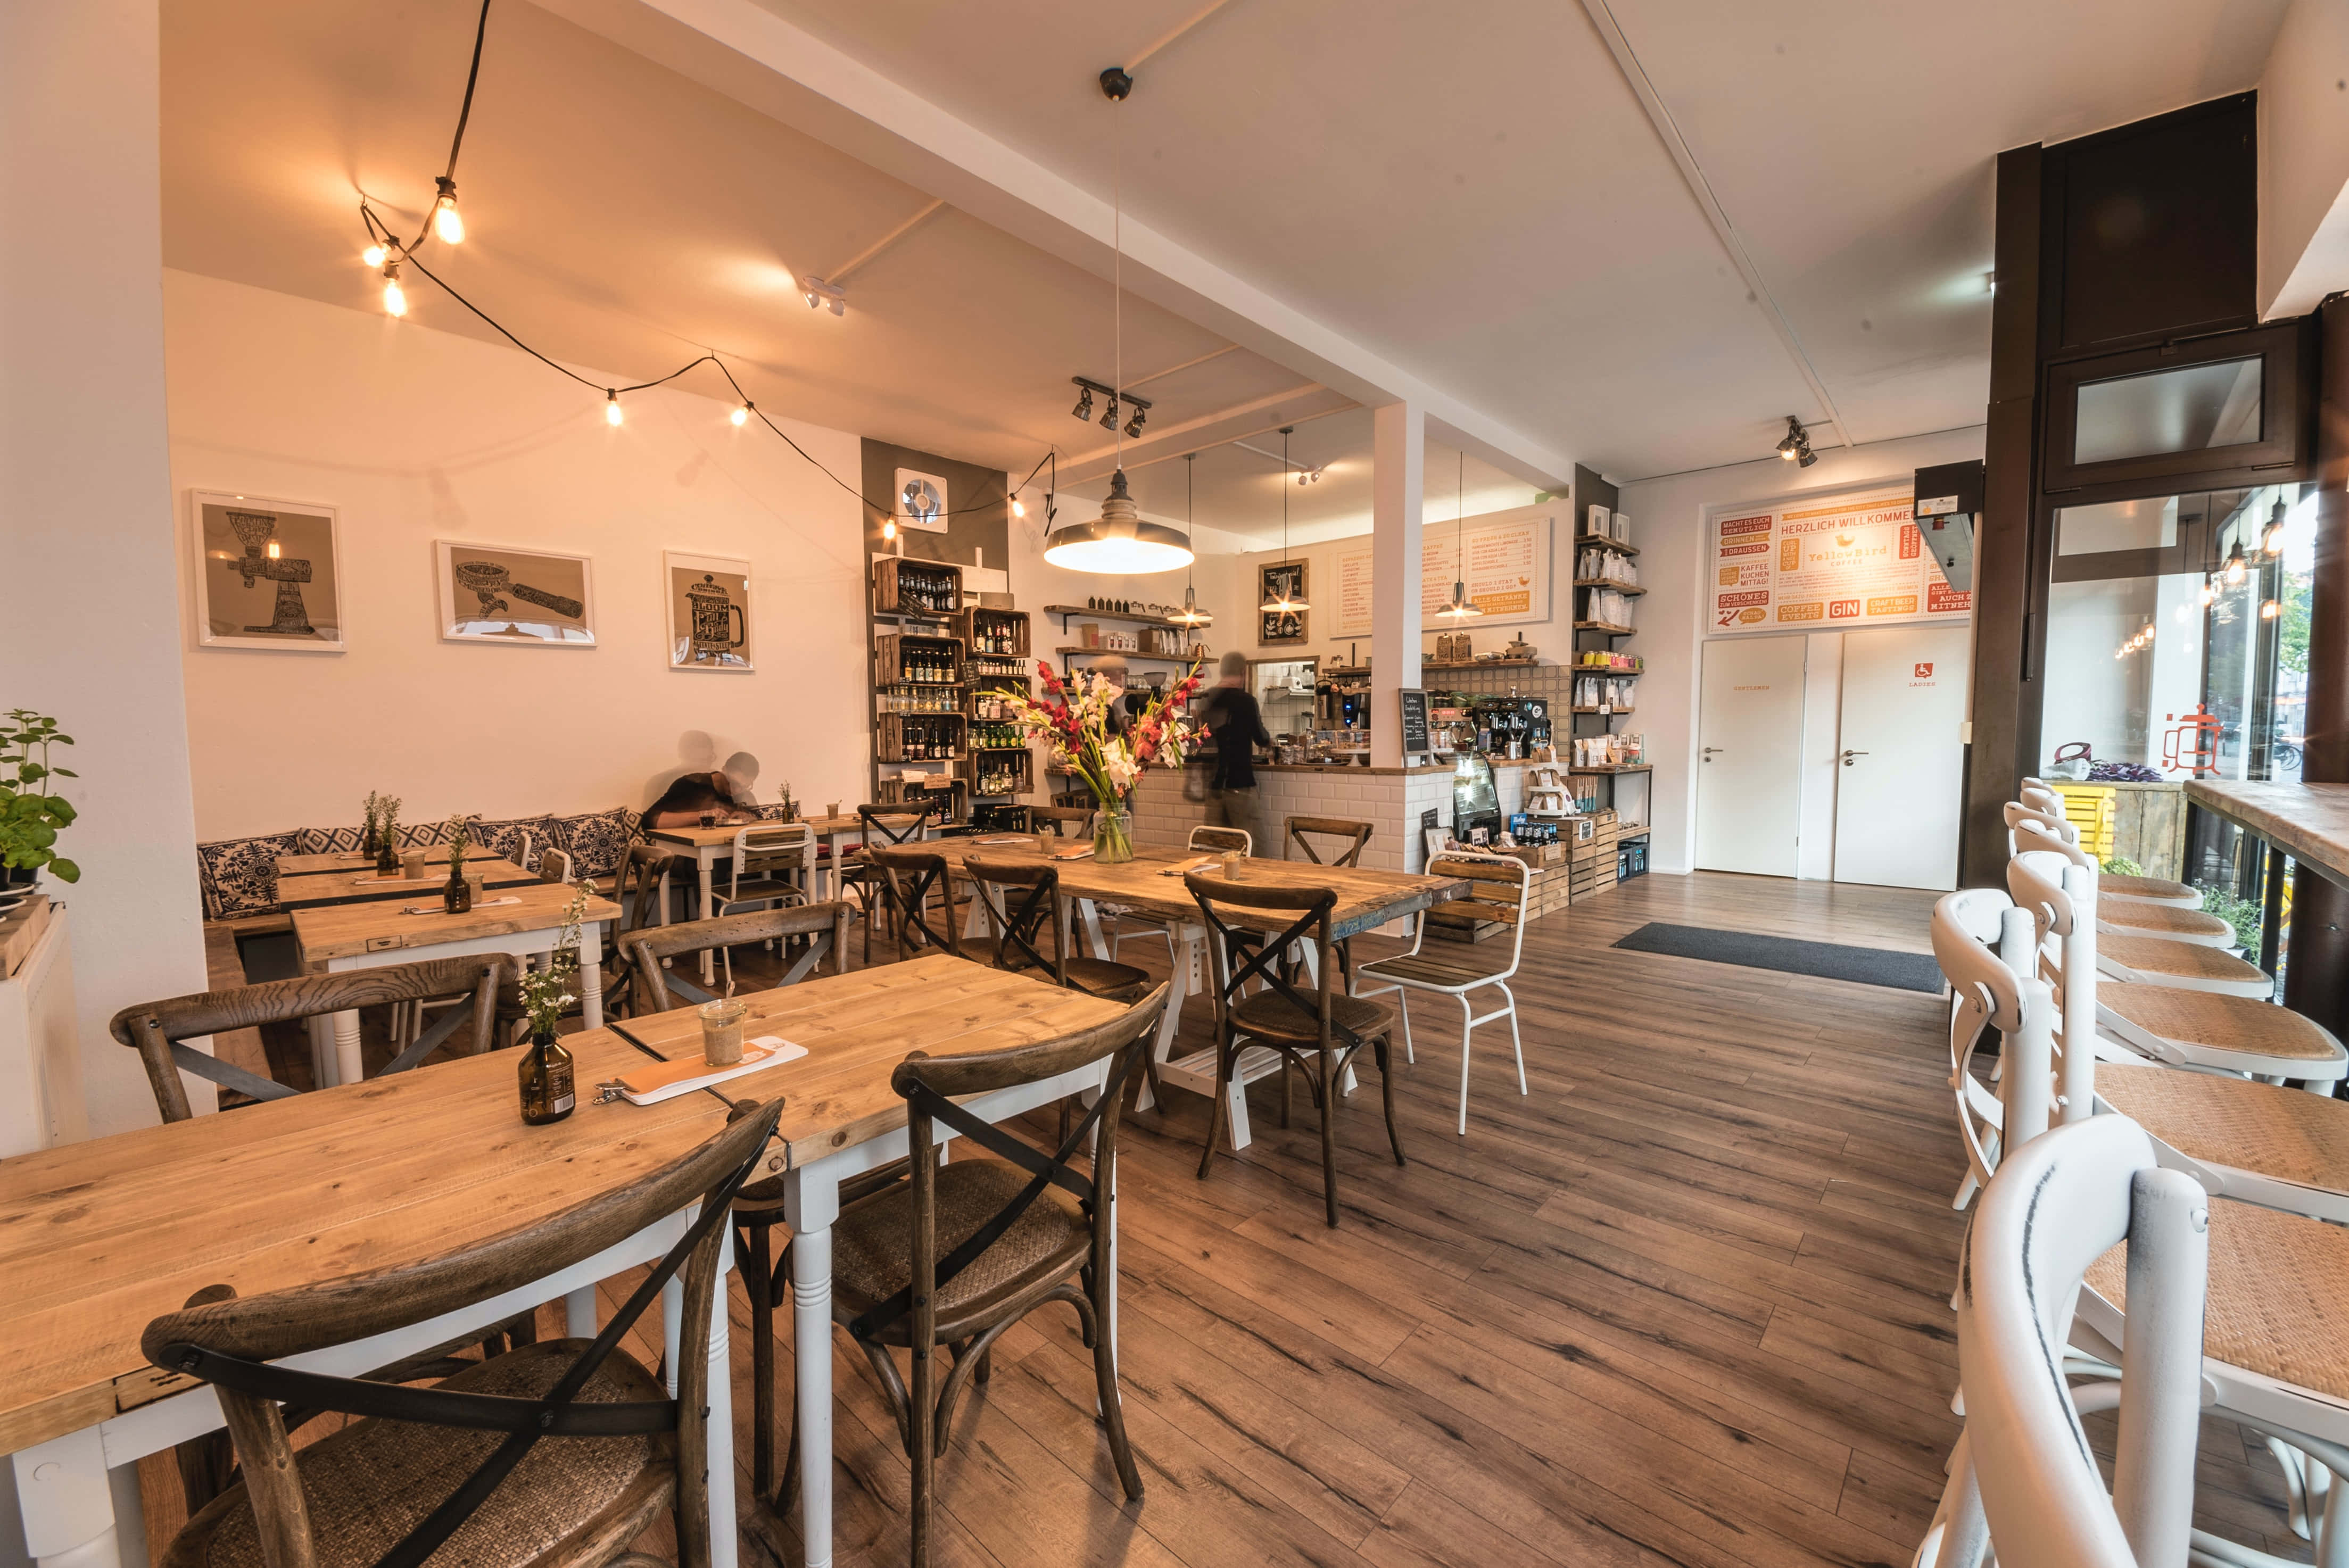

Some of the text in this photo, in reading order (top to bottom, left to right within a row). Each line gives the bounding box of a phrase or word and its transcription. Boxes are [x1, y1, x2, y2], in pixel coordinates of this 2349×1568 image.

[1781, 519, 1835, 535] HERZLICH
[1724, 536, 1755, 545] DRINNEN
[1729, 545, 1766, 554] DRAUSSEN
[1741, 563, 1768, 571] KAFFEE
[1741, 570, 1769, 579] KUCHEN
[1740, 578, 1768, 586] MITTAG!
[1721, 592, 1767, 602] SCHÖNES
[1939, 594, 1964, 602] AUCH
[1871, 599, 1895, 607] CRAFT
[1930, 601, 1971, 610] MITNEH
[1781, 604, 1821, 613] COFFEE
[1832, 602, 1857, 616] GIN
[1871, 604, 1914, 613] TASTINGS
[1781, 611, 1819, 620] EVENTS
